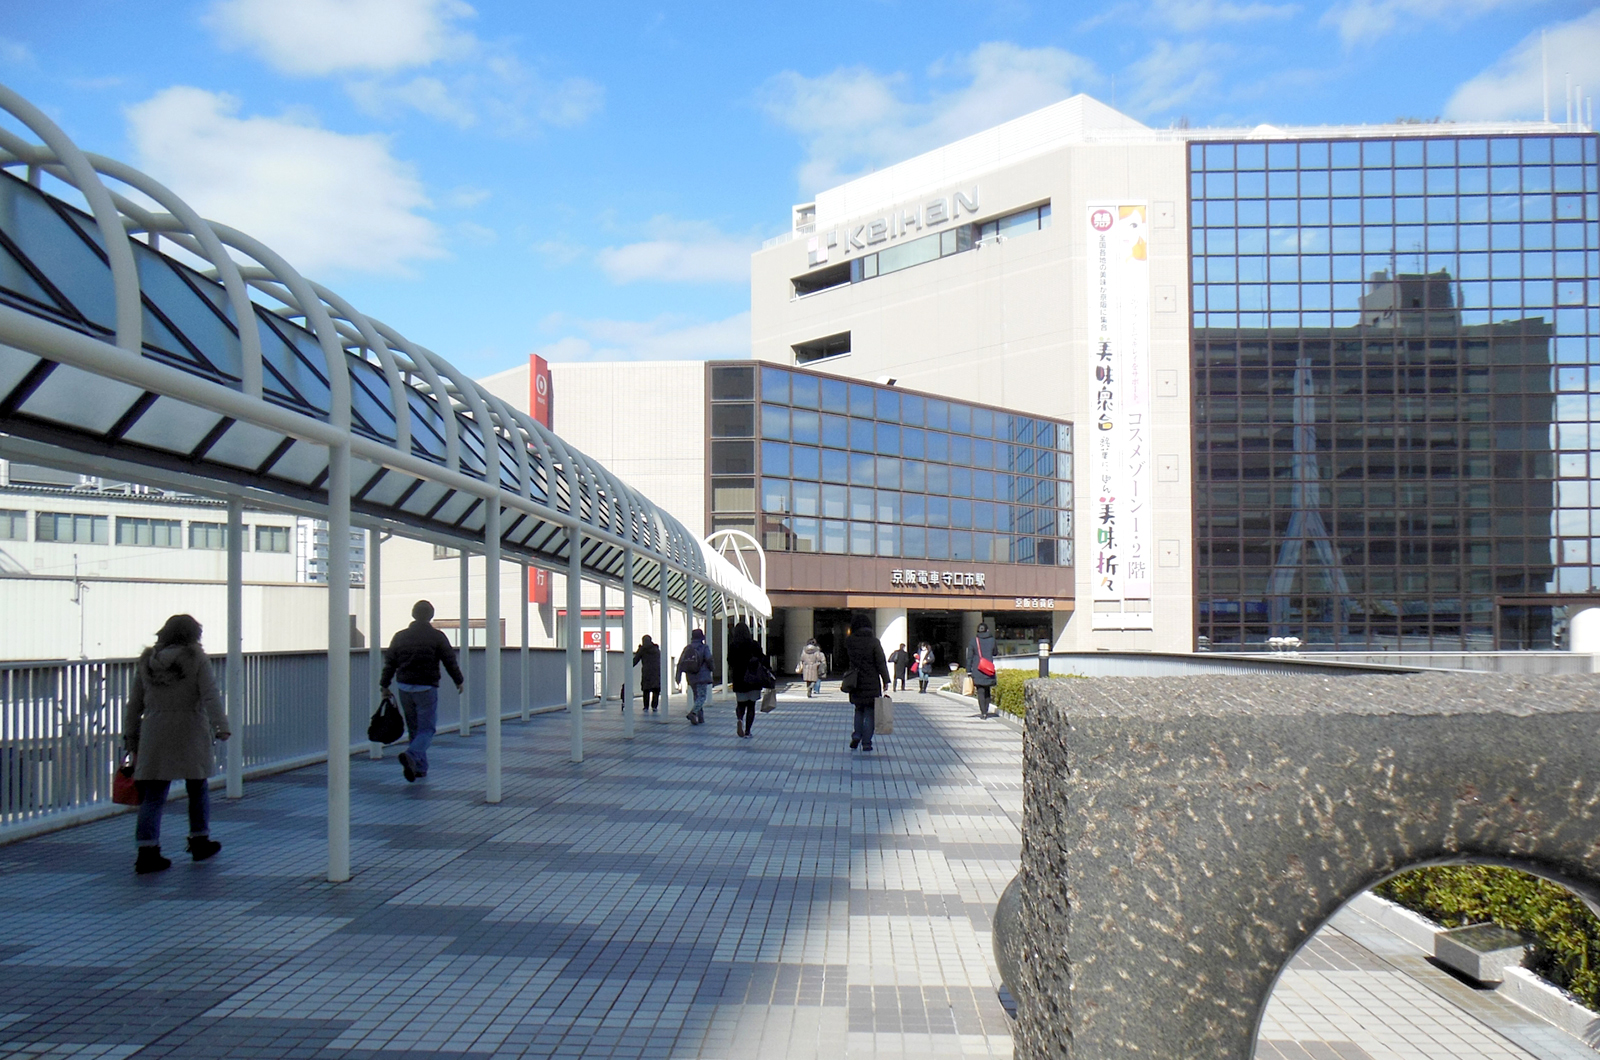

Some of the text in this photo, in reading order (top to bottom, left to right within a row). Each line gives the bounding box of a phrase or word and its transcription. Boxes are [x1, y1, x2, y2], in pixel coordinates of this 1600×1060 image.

[1015, 598, 1055, 609] 京阪百貨店
